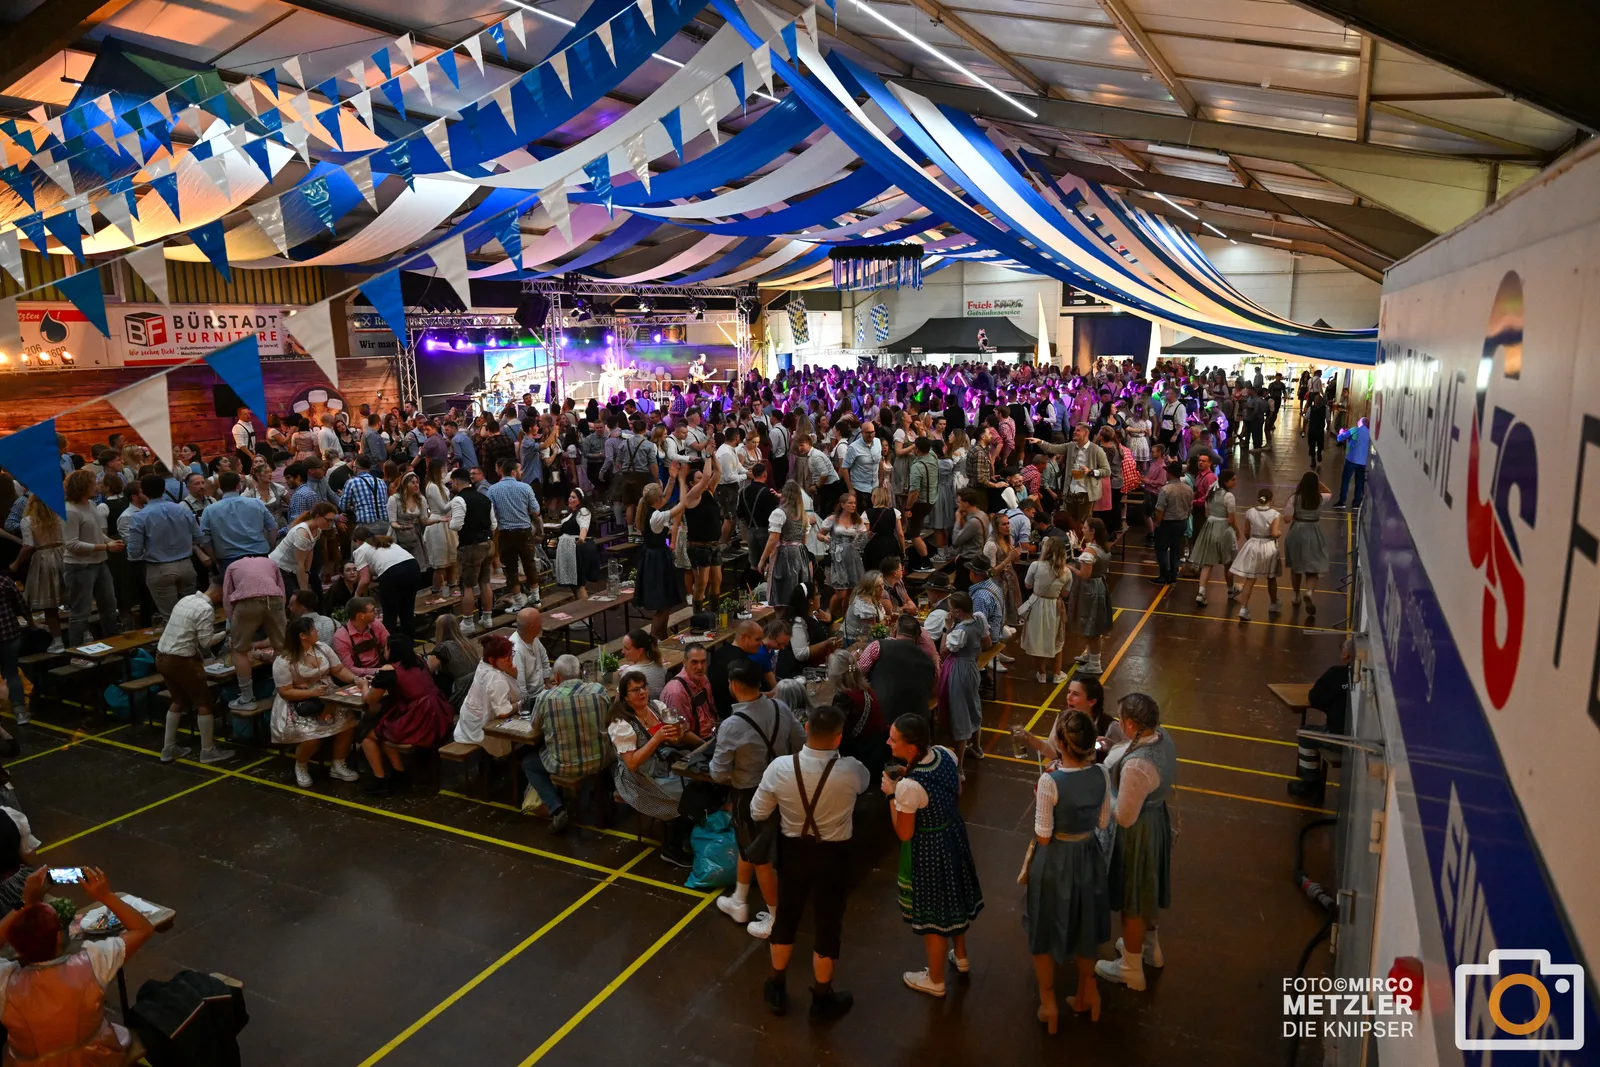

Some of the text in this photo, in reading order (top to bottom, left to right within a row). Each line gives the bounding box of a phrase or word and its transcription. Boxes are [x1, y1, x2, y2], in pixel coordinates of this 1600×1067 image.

[966, 301, 993, 310] Frick
[172, 311, 279, 329] BÜRSTADT
[126, 318, 163, 345] BF
[359, 340, 376, 349] Wir
